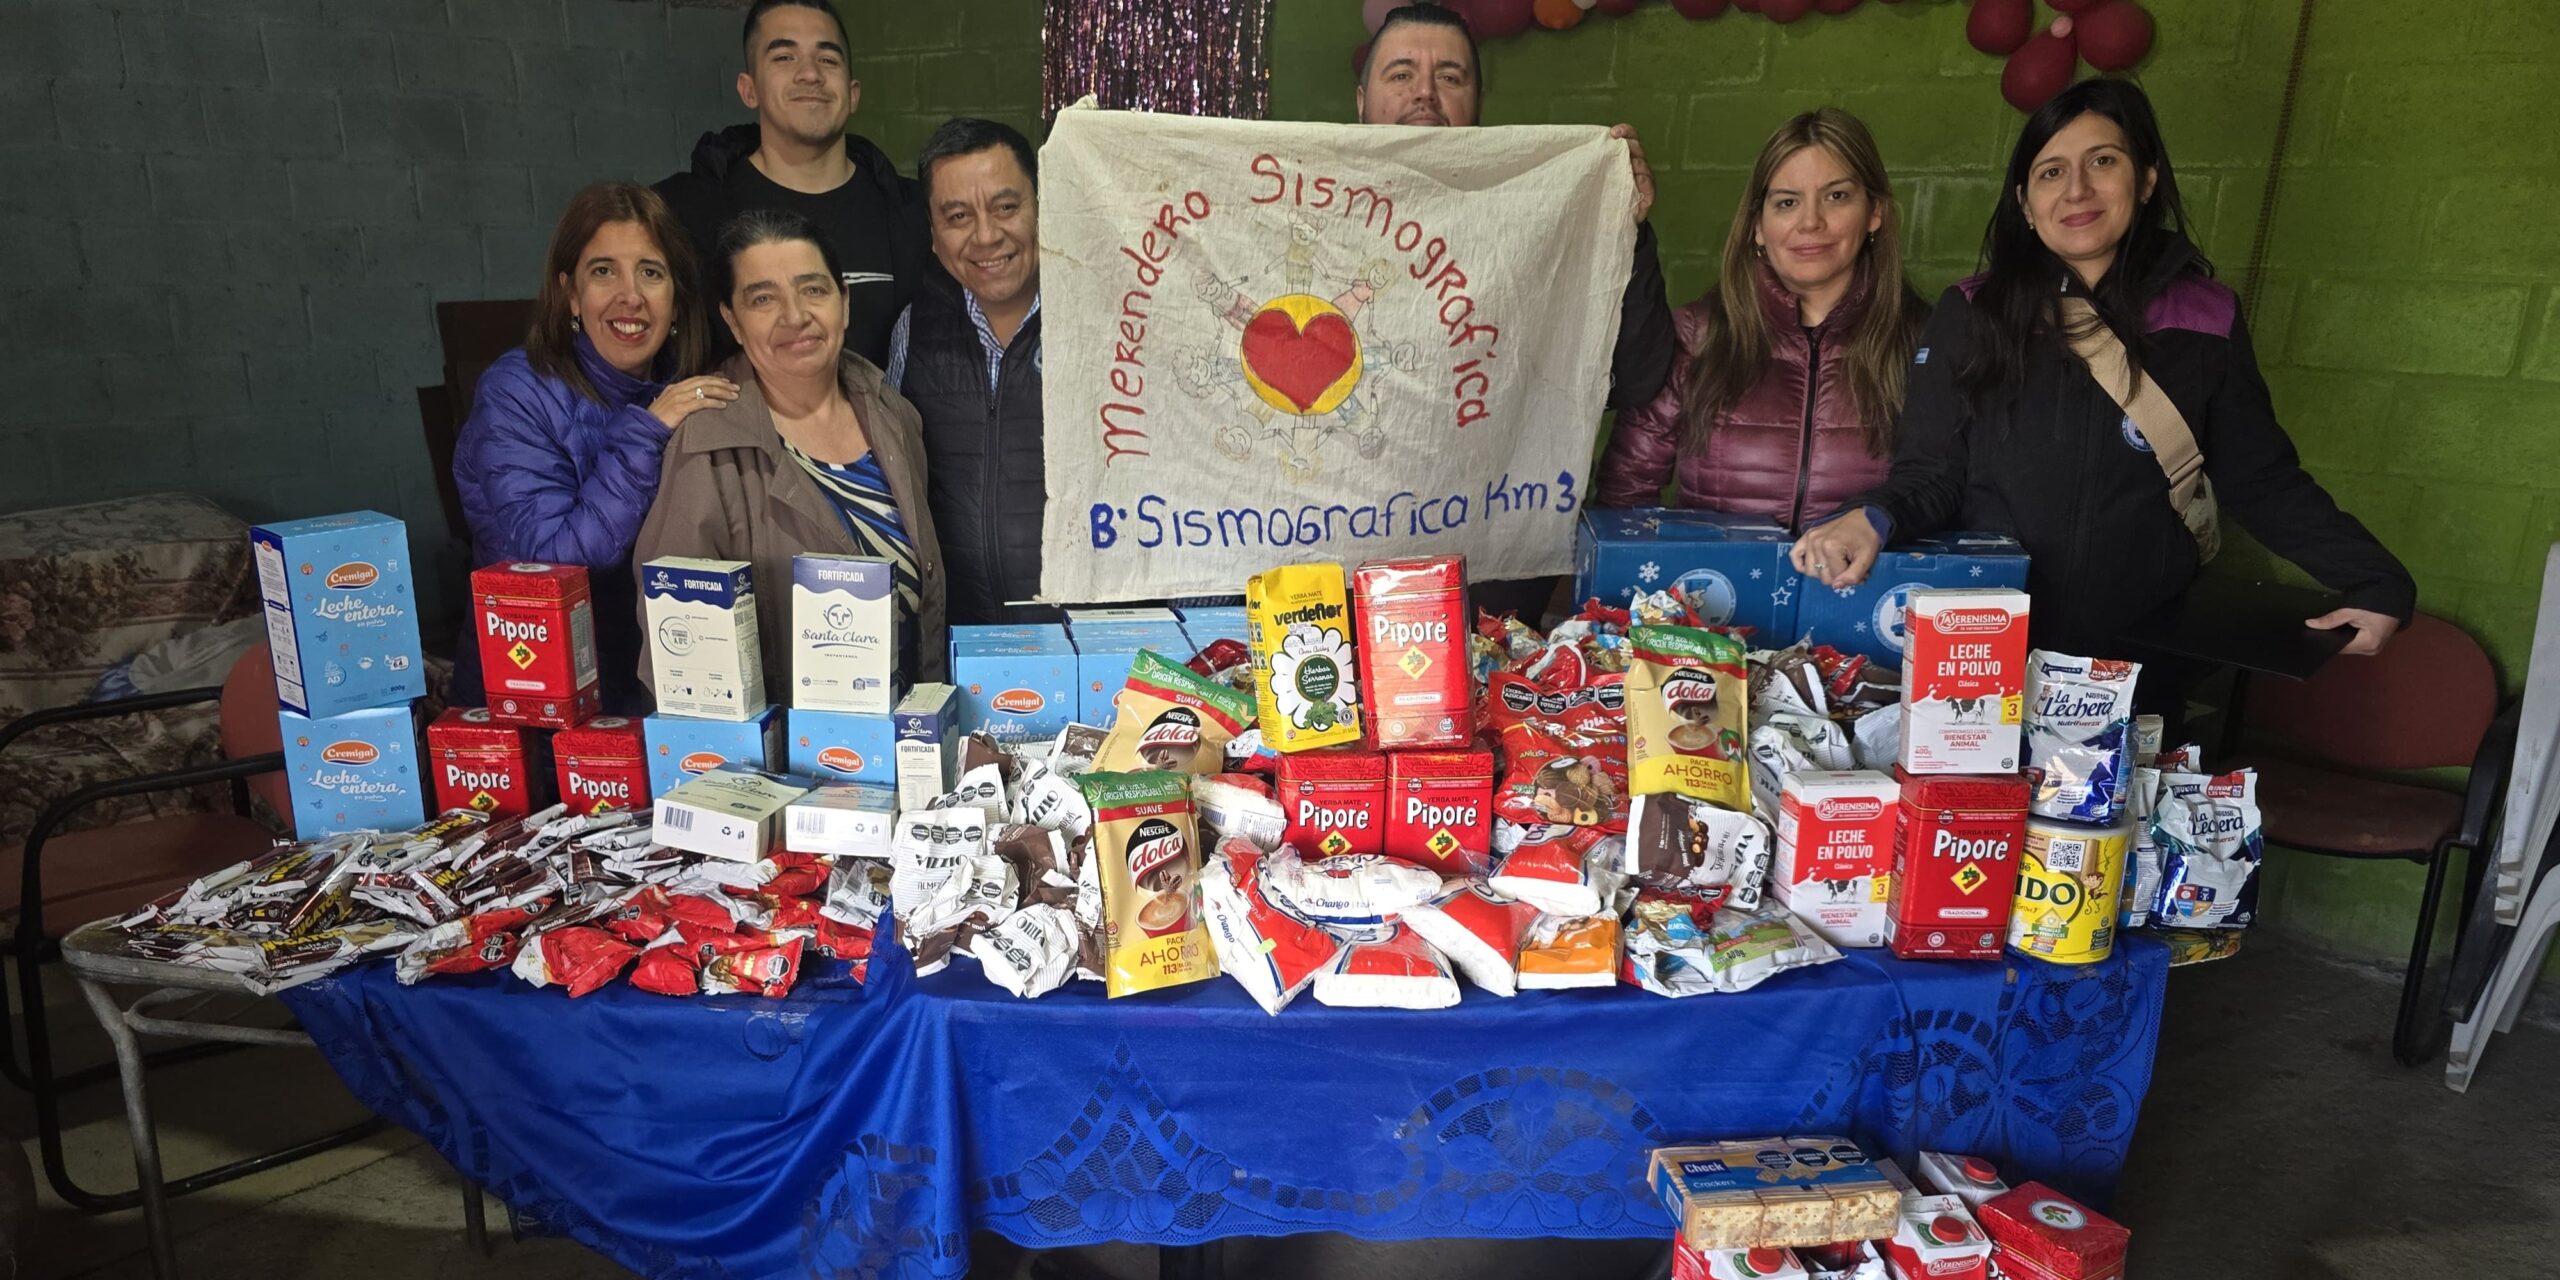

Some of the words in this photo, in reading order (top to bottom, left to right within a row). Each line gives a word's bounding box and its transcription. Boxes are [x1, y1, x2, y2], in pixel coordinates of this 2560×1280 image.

[1484, 473, 1549, 520] Km
[1557, 469, 1577, 513] 3
[330, 569, 374, 583] Cremigal
[818, 570, 864, 583] FORTIFICADA
[684, 579, 723, 592] FORTIFICADA
[1309, 590, 1323, 598] MATE
[315, 595, 364, 619] Leche
[344, 603, 398, 622] entera
[1273, 603, 1344, 626] verdeflor
[486, 611, 548, 642] Piporé
[1373, 612, 1449, 648] Piporé
[802, 629, 840, 641] Santa
[843, 631, 880, 644] Clara
[1950, 644, 1992, 660] LECHE
[1304, 665, 1331, 676] Hierbas
[1937, 662, 1956, 676] EN
[1960, 661, 2001, 676] POLVO
[1302, 673, 1335, 685] Serranas
[1958, 679, 1979, 687] Clásica
[1667, 681, 1713, 700] dolca
[2054, 690, 2071, 703] La
[997, 697, 1040, 708] Cremigal
[1175, 694, 1203, 708] SUAVE
[2042, 697, 2114, 718] Lechera
[2008, 702, 2018, 717] 3
[1144, 725, 1195, 741] dolca
[326, 748, 374, 759] Cremigal
[901, 745, 935, 753] FORTIFICADA
[684, 758, 721, 769] Cremig
[821, 753, 860, 767] Cremigal
[1690, 758, 1710, 767] PACK
[311, 769, 362, 789] Leche
[446, 764, 511, 791] Piporé
[1663, 763, 1733, 785] AHORRO
[341, 782, 400, 794] entera
[568, 771, 629, 799] Piporé
[1684, 778, 1700, 788] 113
[1125, 787, 1163, 799] RESPONSABLE
[1135, 804, 1163, 815] SUAVE
[1299, 799, 1371, 831] Piporé
[1407, 797, 1478, 829] Piporé
[2191, 817, 2245, 835] Lecera
[1828, 829, 1866, 844] LECHE
[1817, 846, 1833, 860] EN
[1836, 844, 1873, 859] POLVO
[1933, 829, 2012, 864] Piporé
[1132, 836, 1182, 873] dolca
[1876, 883, 1885, 896] 3
[2015, 874, 2077, 906] IDO
[1315, 898, 1350, 910] Chango
[1820, 911, 1858, 919] BIENESTAR
[1166, 936, 1185, 945] PACK
[1140, 943, 1199, 967] AHORRO
[1163, 963, 1177, 975] 113
[1683, 1161, 1726, 1173] Check
[1693, 1179, 1736, 1188] Crackers
